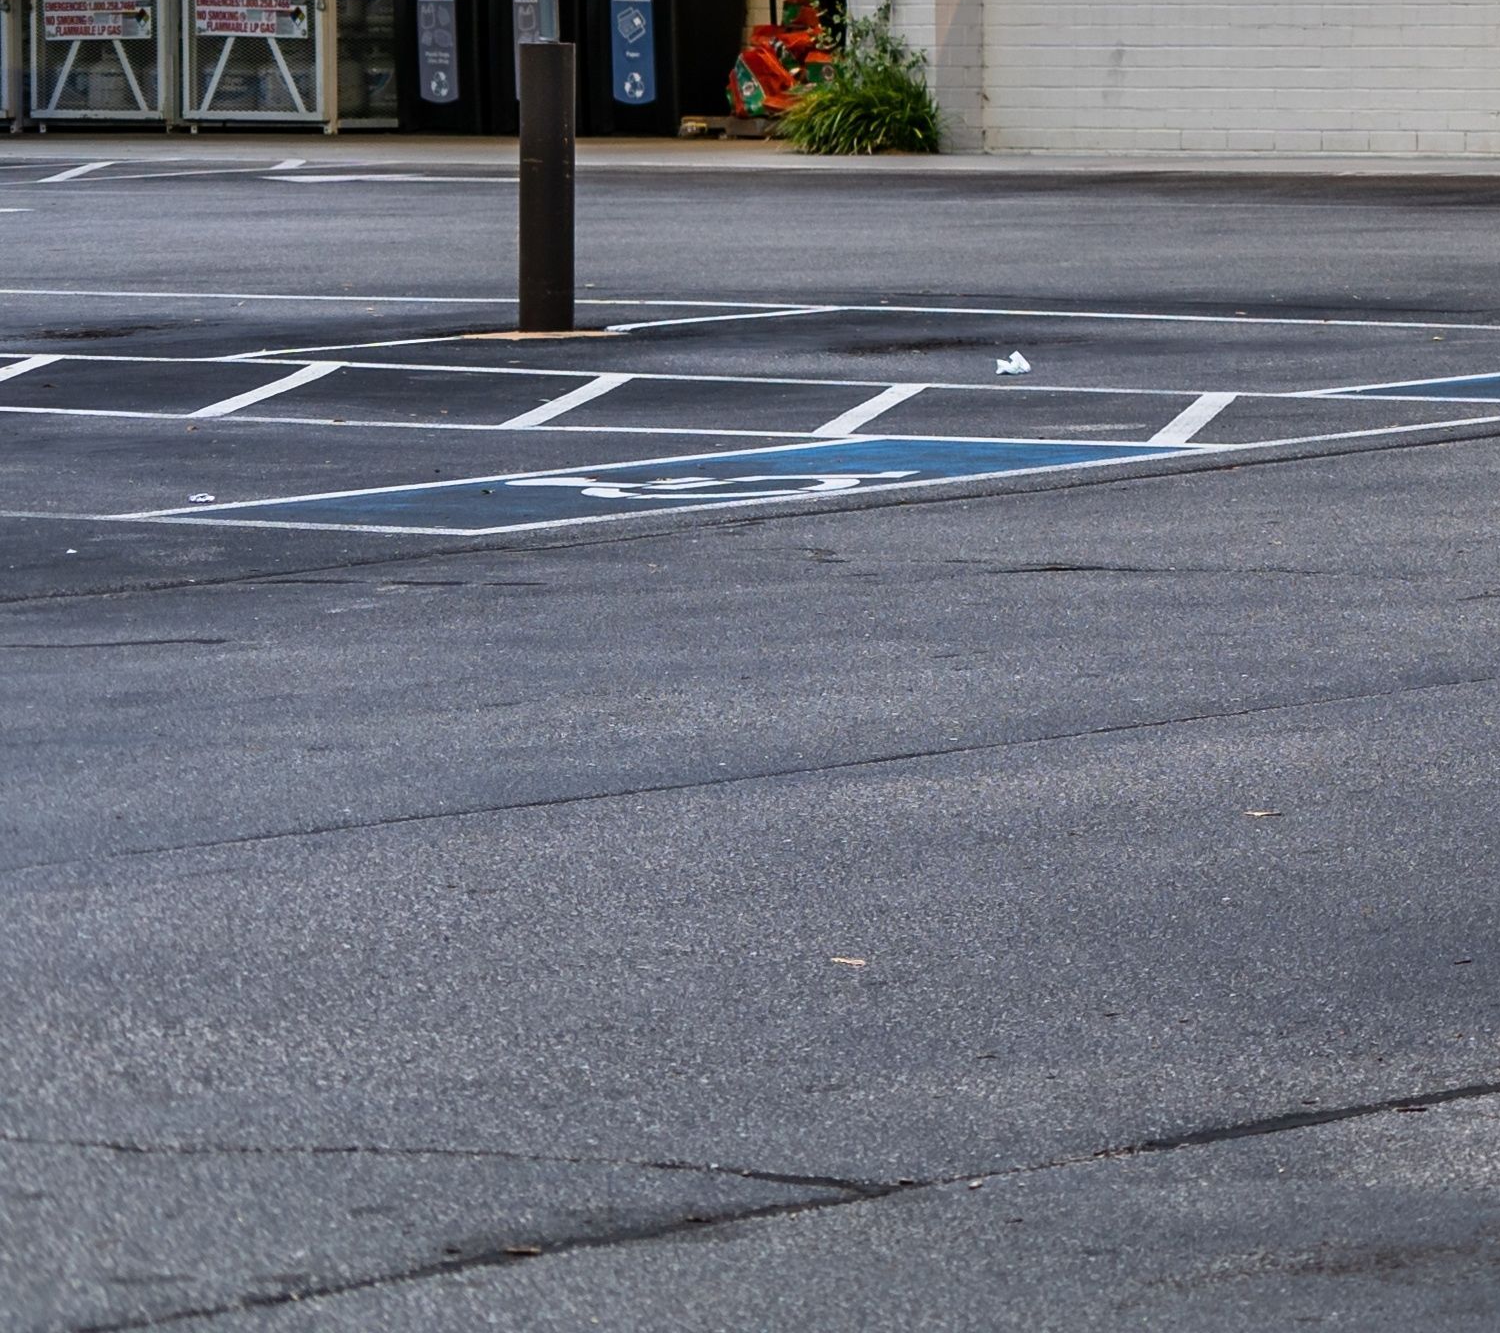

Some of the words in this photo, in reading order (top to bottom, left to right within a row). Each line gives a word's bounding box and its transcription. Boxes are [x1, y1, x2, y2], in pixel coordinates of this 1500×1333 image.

[207, 10, 239, 21] SMOKING
[206, 21, 248, 33] FLAMMABLE
[259, 22, 275, 33] GAS
